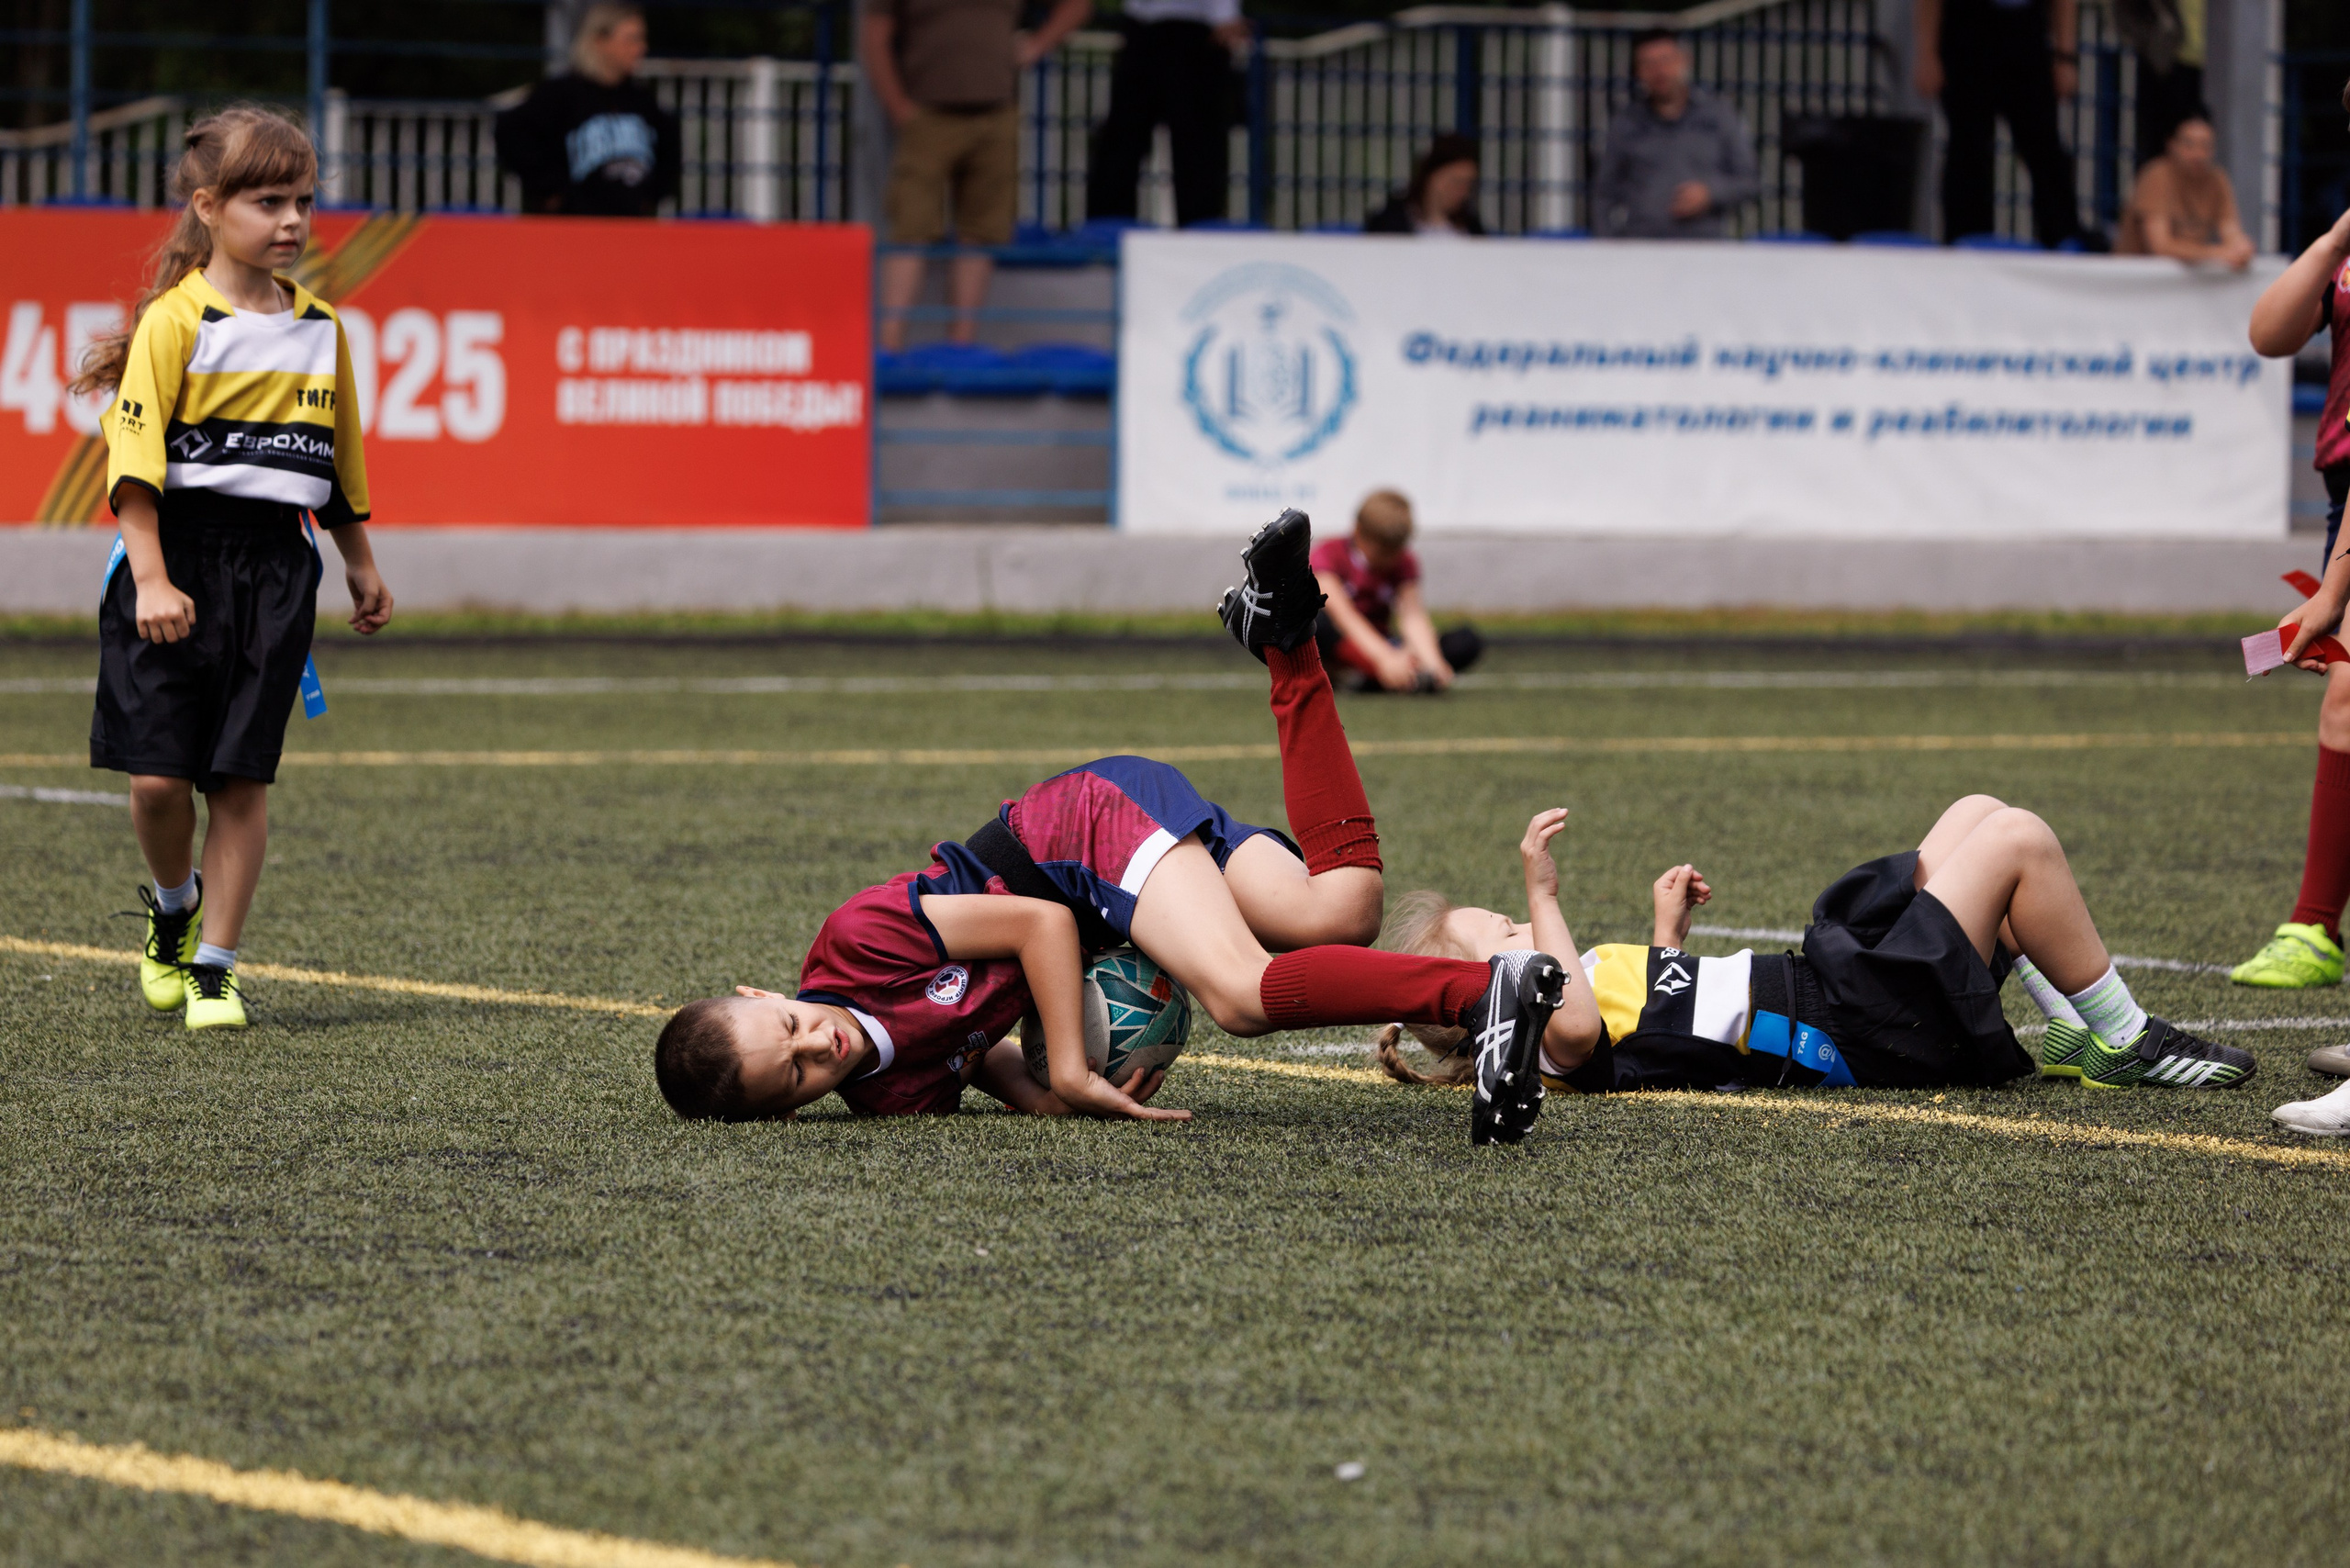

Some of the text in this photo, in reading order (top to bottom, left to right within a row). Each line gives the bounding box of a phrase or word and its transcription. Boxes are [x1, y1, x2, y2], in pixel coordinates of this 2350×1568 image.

[1403, 331, 1699, 379] Федеральный
[2147, 352, 2263, 389] центр
[955, 979, 967, 998] ЦЕНТР
[1797, 1031, 1808, 1055] TAG
